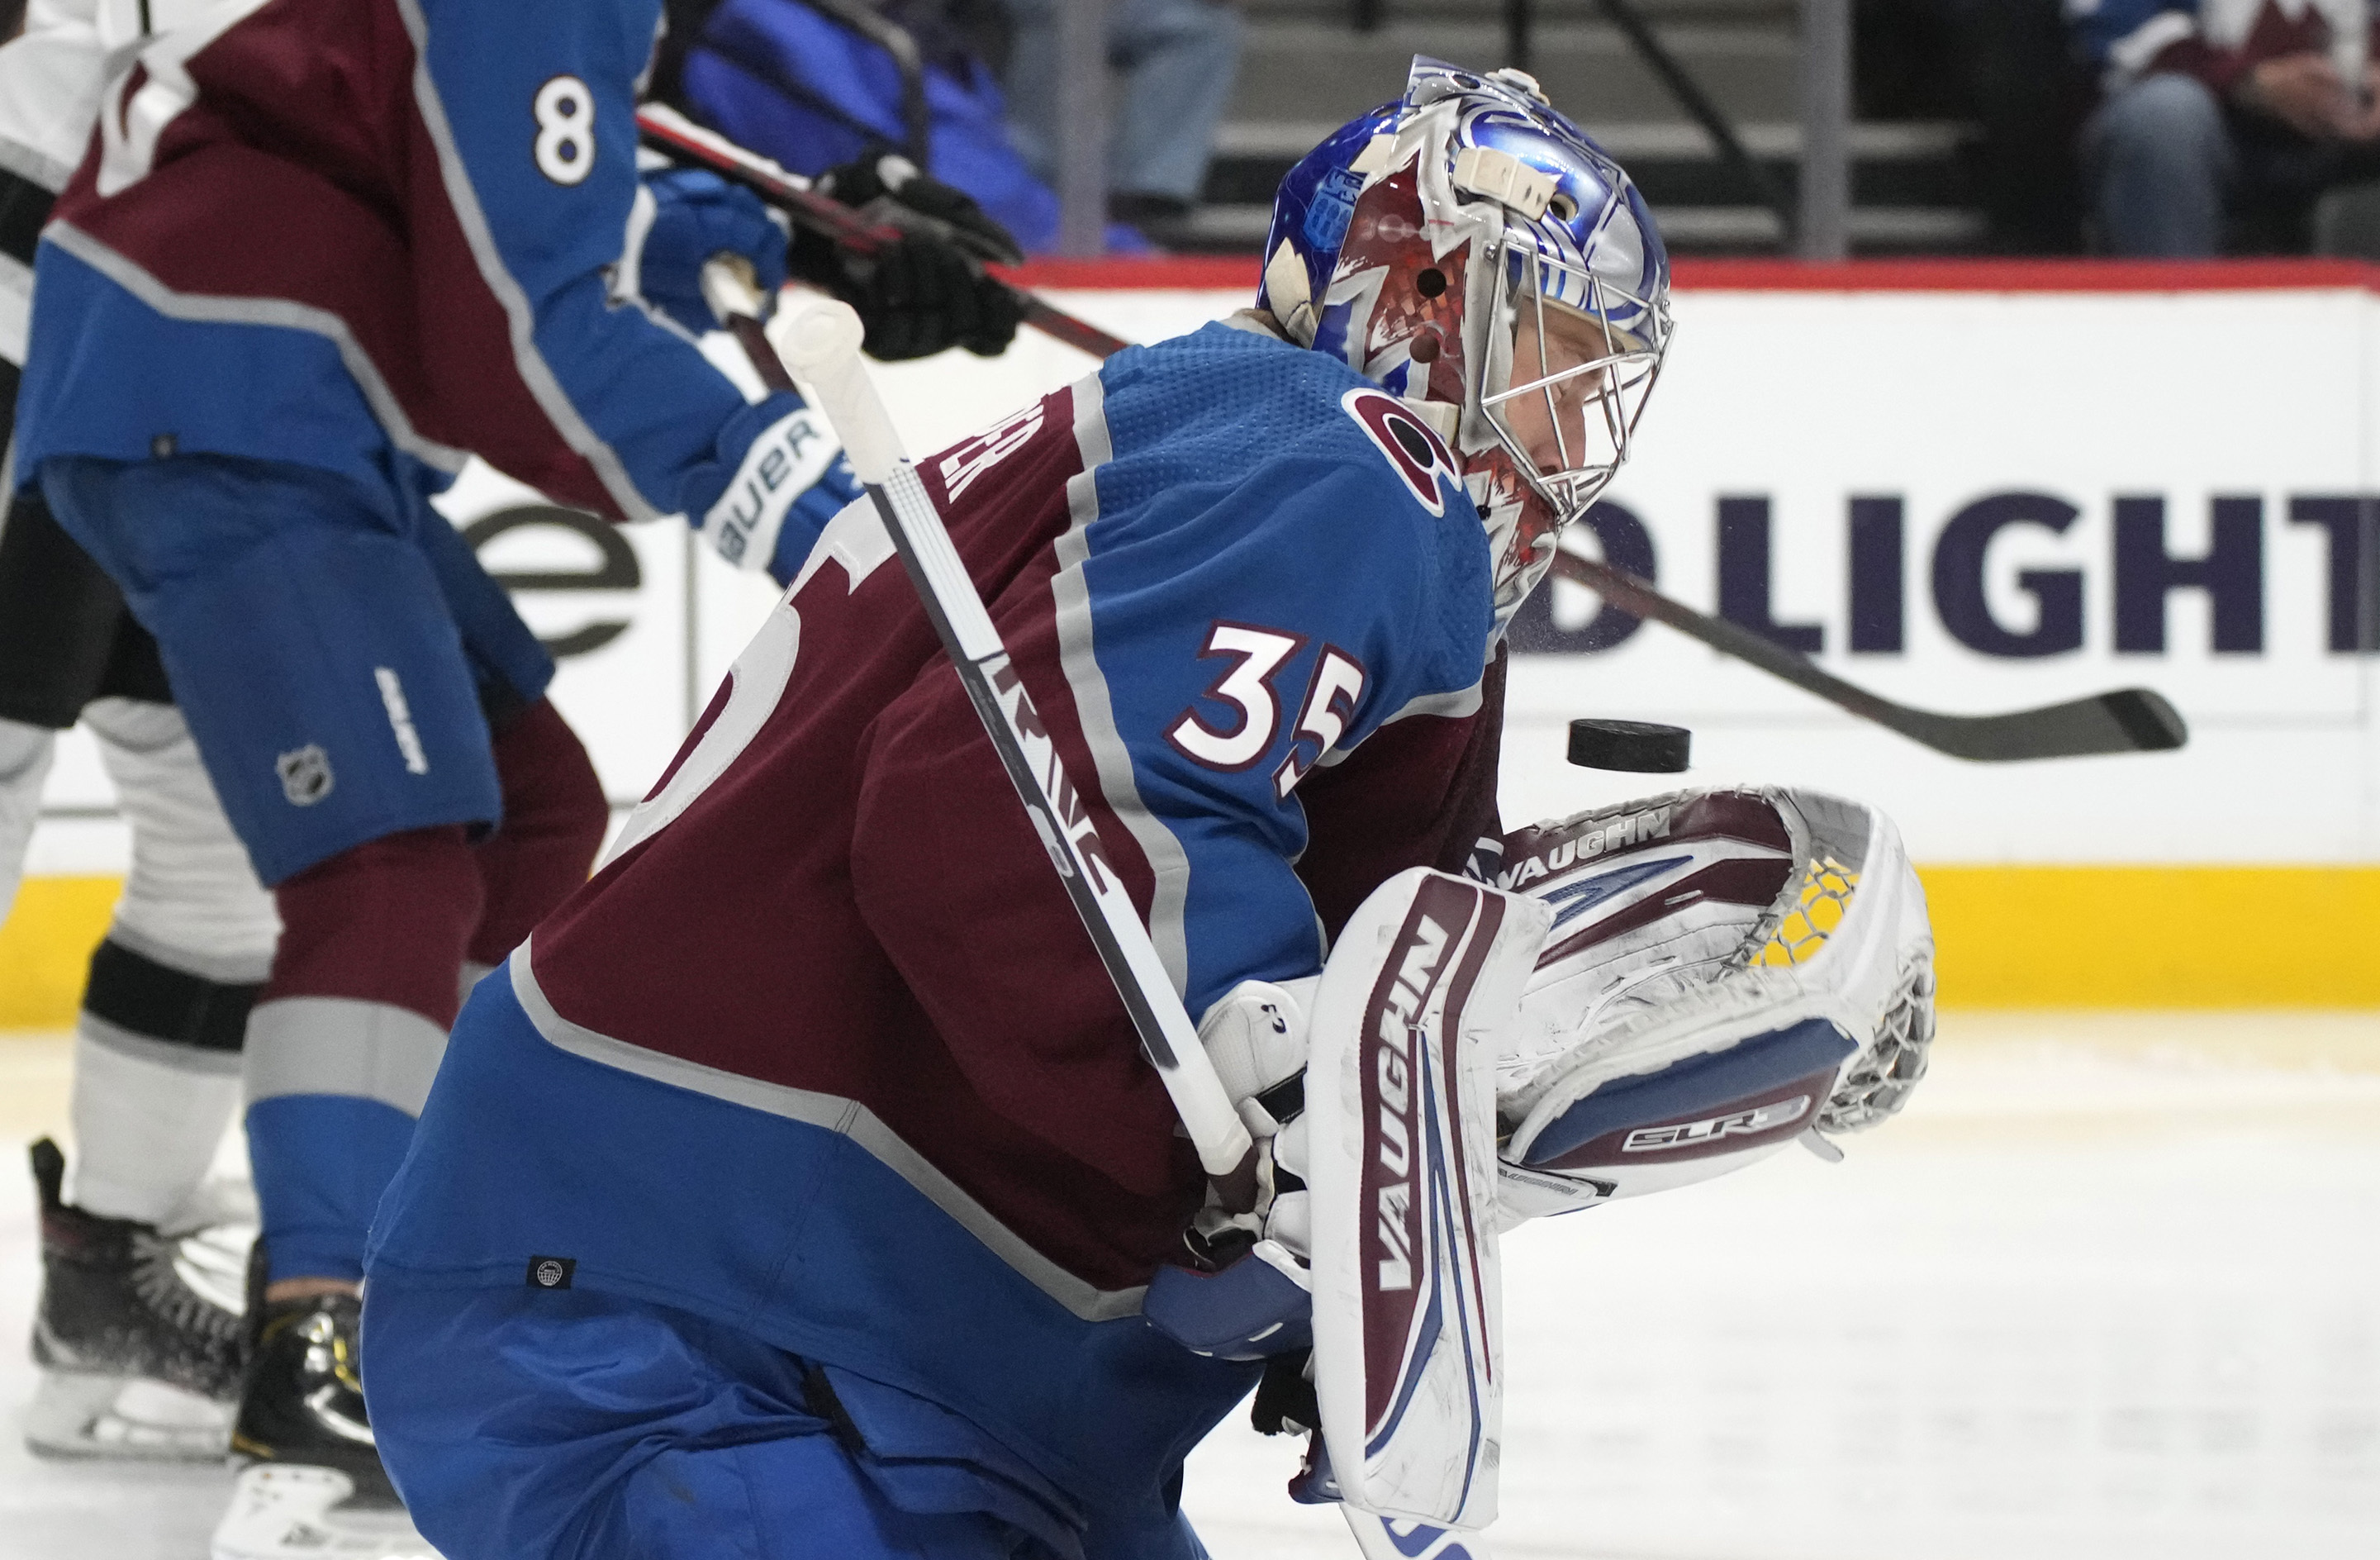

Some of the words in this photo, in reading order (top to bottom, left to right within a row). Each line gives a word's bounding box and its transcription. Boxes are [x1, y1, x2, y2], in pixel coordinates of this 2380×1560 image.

[533, 74, 596, 188] 8
[1715, 492, 2380, 659] LIGHT
[1165, 621, 1366, 801] 35
[1495, 810, 1671, 891] VAUGHN
[1379, 914, 1450, 1291] VAUGHN
